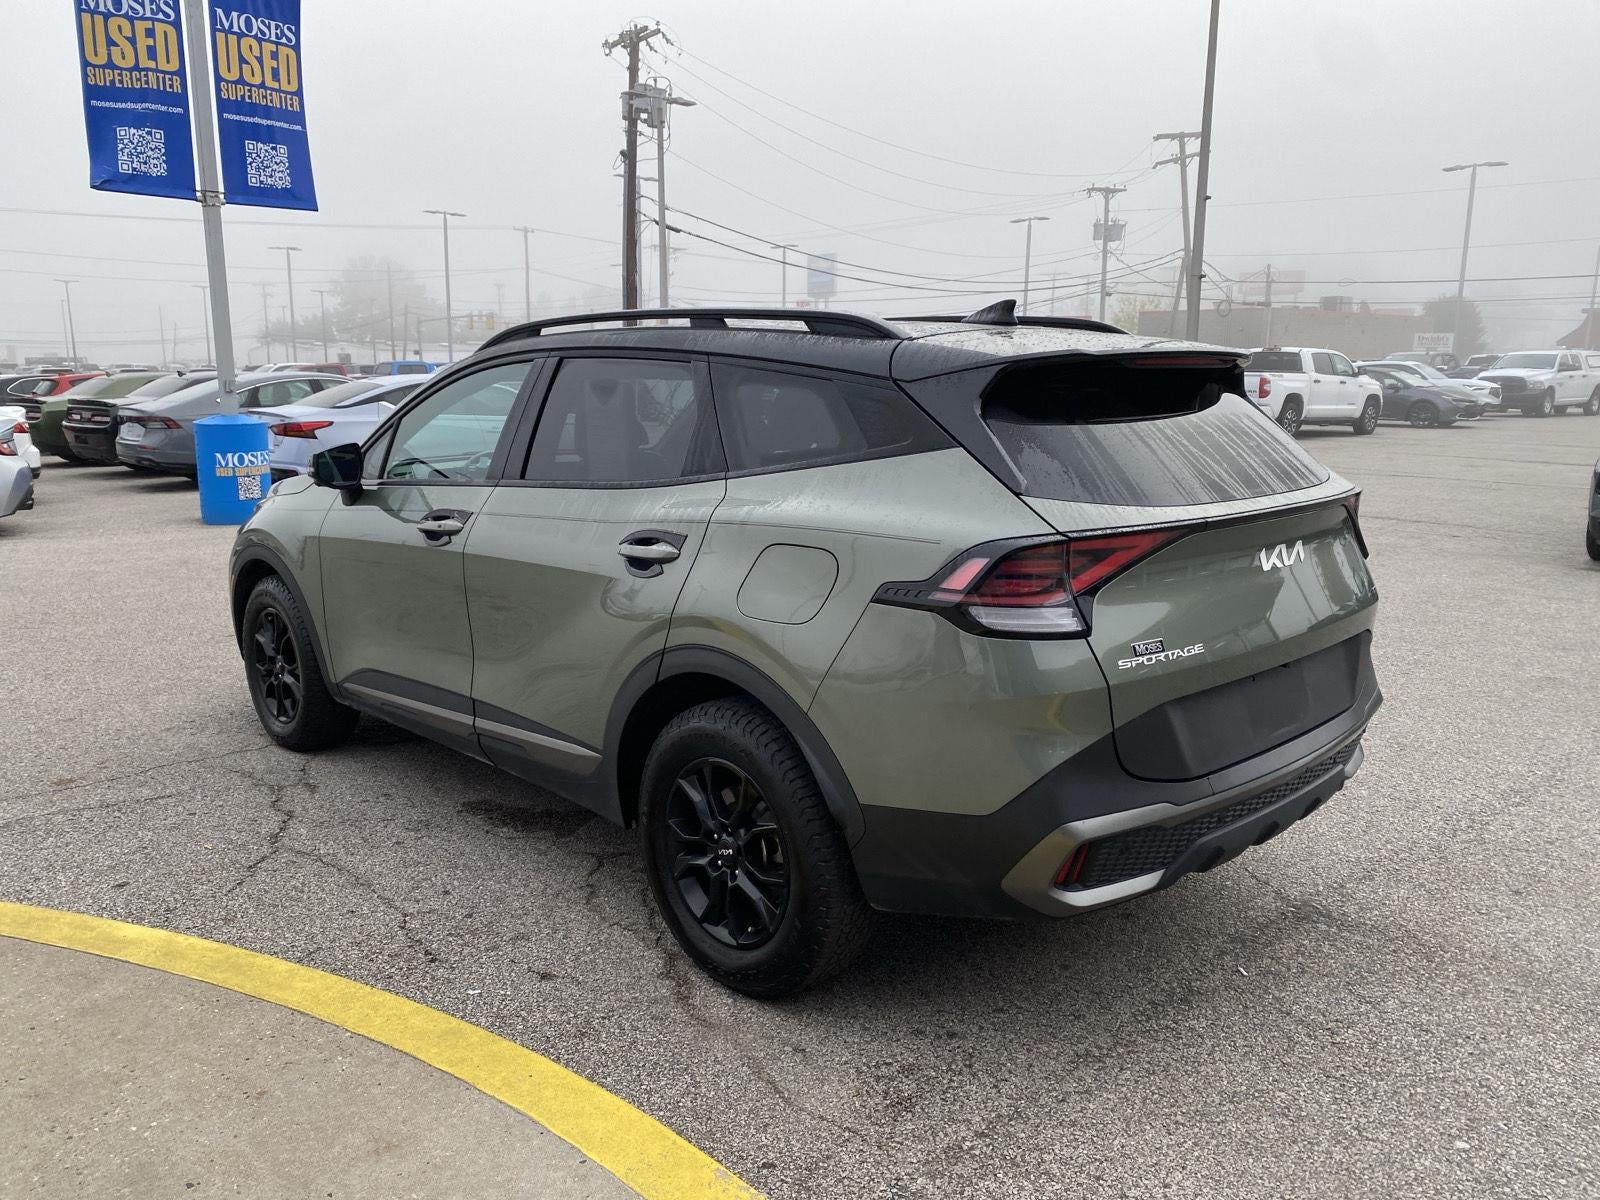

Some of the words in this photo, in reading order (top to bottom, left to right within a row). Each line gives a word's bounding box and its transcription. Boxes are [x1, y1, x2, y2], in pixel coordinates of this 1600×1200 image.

[215, 8, 296, 45] MOSES
[81, 12, 179, 72] USED
[215, 32, 298, 92] USED
[86, 66, 181, 93] SUPERCENTER
[90, 100, 184, 114] mosesusedsupercenter.com
[220, 82, 300, 112] SUPERCENTER
[223, 113, 303, 130] mosesusedsupercenter.com
[214, 450, 270, 468] MOSES
[1259, 540, 1305, 571] KIA
[1118, 643, 1205, 670] SPORTAGE
[1133, 642, 1164, 656] MOSES
